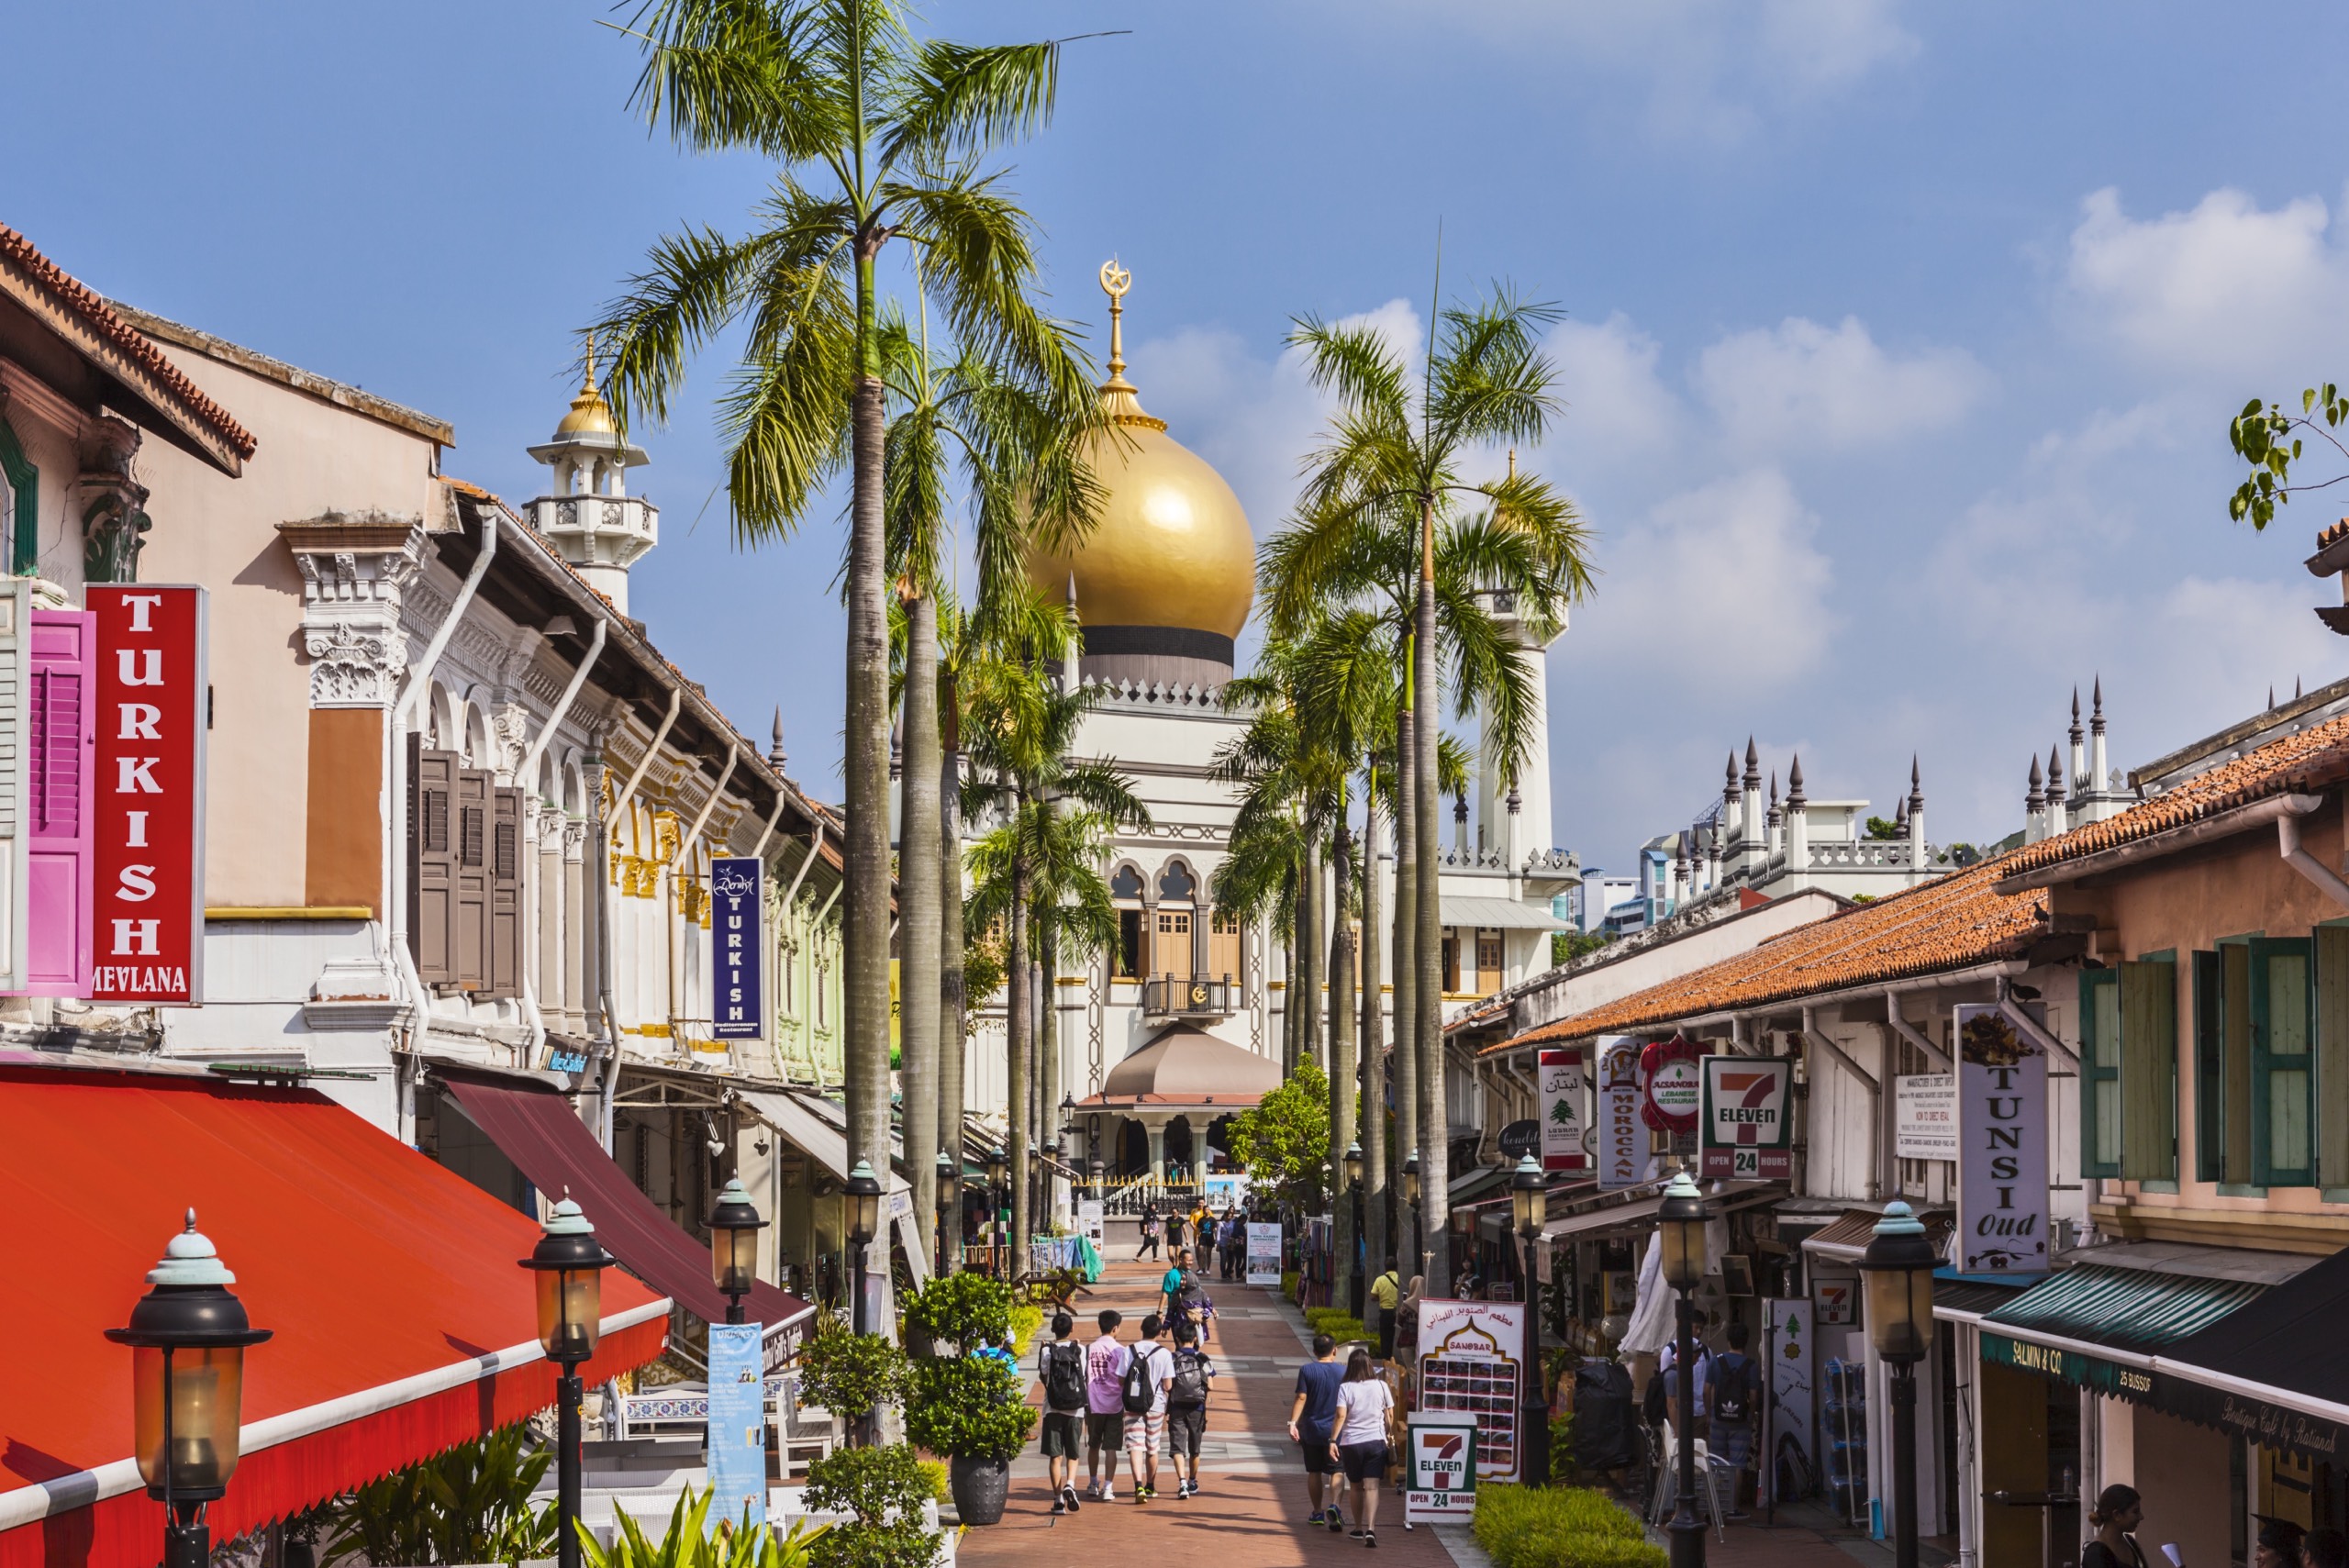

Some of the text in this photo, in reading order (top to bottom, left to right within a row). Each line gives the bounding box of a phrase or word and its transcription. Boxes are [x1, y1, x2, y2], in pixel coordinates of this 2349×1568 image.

[111, 595, 164, 956] TURKISH
[729, 897, 743, 1020] TURKISH
[1545, 1078, 1578, 1093] لبنان
[1653, 1081, 1699, 1089] ALSANOBA
[1720, 1073, 1775, 1144] 7
[1612, 1095, 1635, 1178] MOROCCAN
[1986, 1067, 2023, 1209] TUNSI
[1709, 1152, 1787, 1172] OPEN 24 HOURS
[1977, 1214, 2037, 1237] Oud
[1450, 1341, 1491, 1351] SANOBAR
[2042, 1349, 2047, 1371] &
[2120, 1371, 2127, 1385] 25
[2222, 1396, 2257, 1435] Boutique
[2259, 1406, 2278, 1442] Café
[2281, 1414, 2290, 1447] by
[1423, 1434, 1463, 1488] 7
[1410, 1494, 1475, 1507] OPEN 24 HOURS
